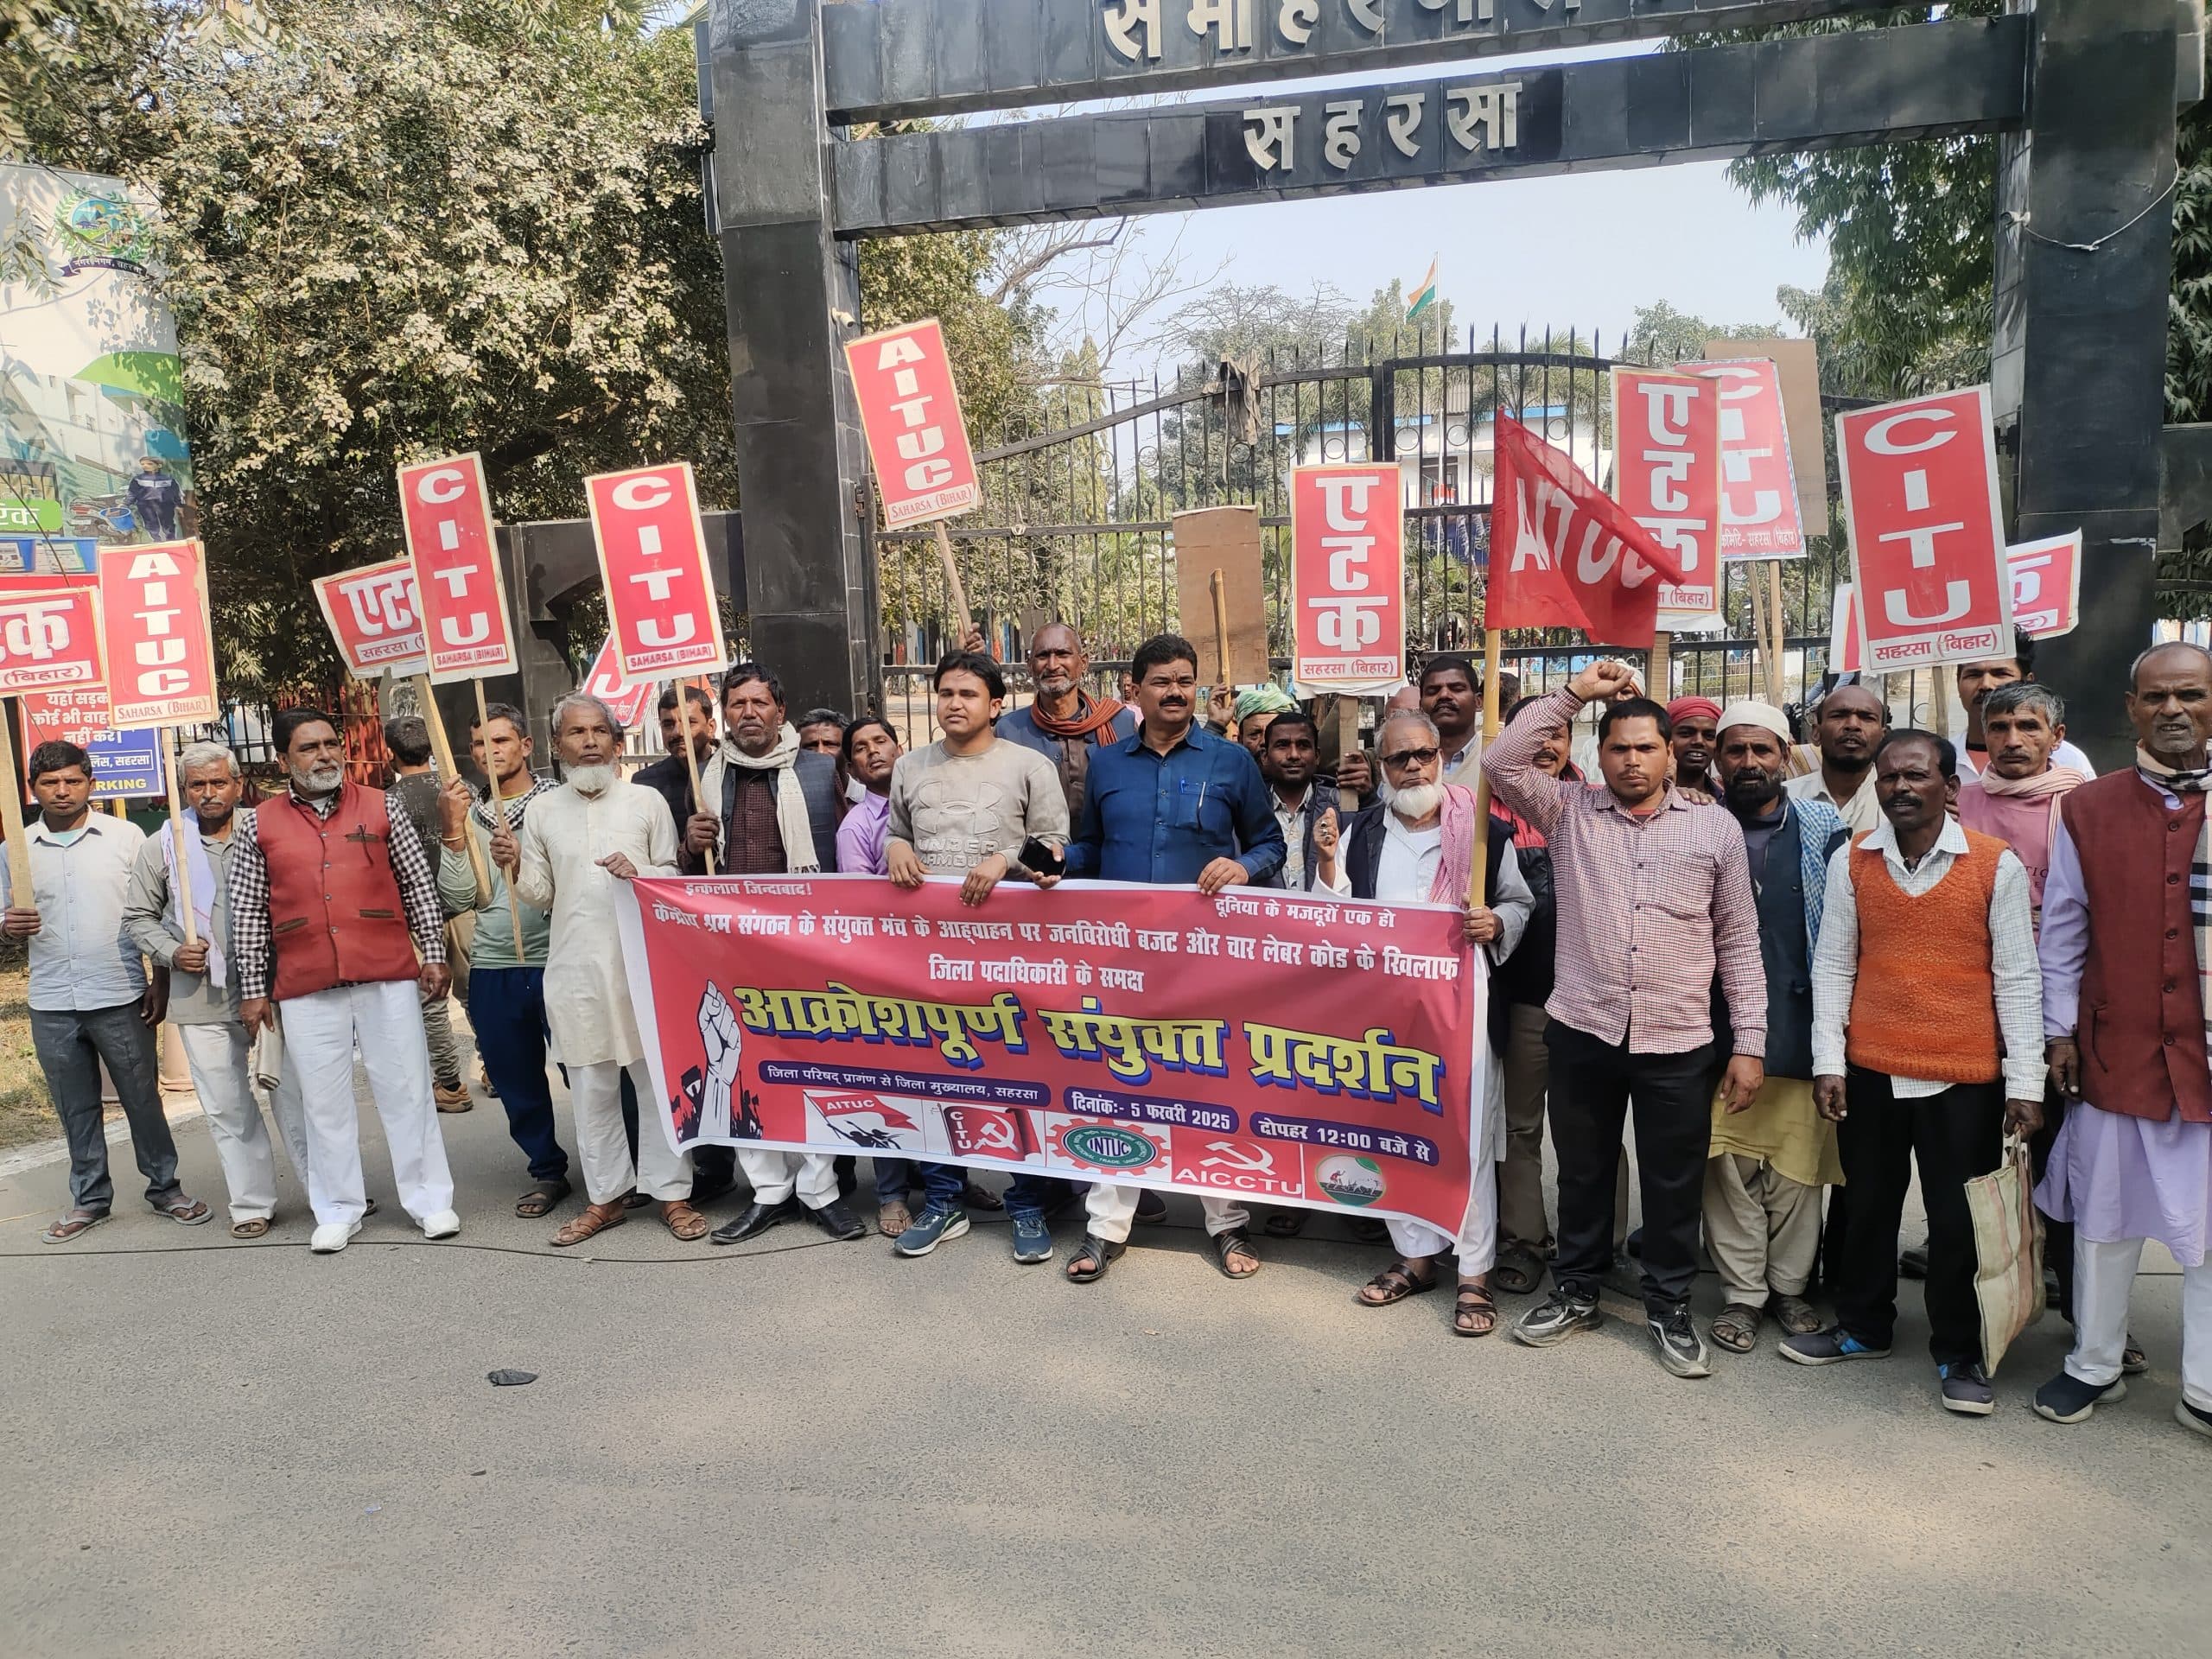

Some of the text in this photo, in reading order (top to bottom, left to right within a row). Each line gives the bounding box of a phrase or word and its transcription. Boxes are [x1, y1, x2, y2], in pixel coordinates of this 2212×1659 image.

[1243, 82, 1522, 171] सहरसा
[878, 336, 953, 491] AITUC
[891, 486, 972, 518] SAHARSA (BIHAR)
[1864, 409, 1971, 626] CITU
[417, 469, 490, 646] CITU
[612, 476, 696, 647] CITU
[1307, 476, 1388, 652] एटक
[339, 569, 423, 637] एट
[1670, 585, 1709, 607] (बिहार)
[127, 552, 190, 696] AITUC
[360, 639, 409, 658] सहरसा
[436, 651, 473, 666] SAHARSA
[630, 646, 712, 669] SAHARSA (BIHAR)
[1875, 629, 1998, 661] सहरसा (बिहार)
[3, 664, 84, 686] (बिहार)
[1304, 660, 1393, 676] सहरसा (बिहार)
[31, 709, 109, 727] कोई भी वाह
[118, 706, 162, 721] SAHARSA
[115, 754, 150, 766] सहरसा
[92, 779, 146, 791] RKING
[1214, 895, 1395, 928] दूनिया के मजदूरों एक हो
[703, 914, 733, 934] श्रम
[737, 908, 792, 935] संगठन
[797, 910, 817, 936] के
[822, 910, 874, 944] संयुक्त
[879, 913, 908, 937] मंच
[911, 914, 931, 938] के
[1018, 923, 1042, 942] पर
[1046, 919, 1130, 949] जनविरोधी
[1135, 929, 1179, 952] बजट
[1185, 926, 1220, 957] और
[1225, 935, 1256, 960] चार
[1262, 934, 1303, 965] लेबर
[1309, 939, 1349, 968] कोड
[1354, 943, 1376, 970] के
[1382, 945, 1459, 981] खिलाफ
[928, 953, 1145, 993] जिला पदाधिकारी के समक्ष
[733, 981, 1445, 1112] आक्रोशपूर्ण संयुक्त प्रदर्शन
[767, 1065, 798, 1079] जिला
[802, 1067, 842, 1084] परिषद्
[879, 1074, 892, 1086] से
[896, 1074, 925, 1090] जिला
[931, 1081, 991, 1097] मुख्यालय,
[995, 1086, 1039, 1101] सहरसा
[827, 1099, 875, 1110] AITUC
[1131, 1103, 1140, 1118] 5
[1146, 1104, 1187, 1123] फरवरी
[1192, 1110, 1230, 1129] 2025
[950, 1111, 972, 1150] CITU
[1259, 1118, 1431, 1163] दोपहर 12:00 बजे से
[1090, 1137, 1129, 1157] INTUC
[1175, 1167, 1303, 1195] AICCTU
